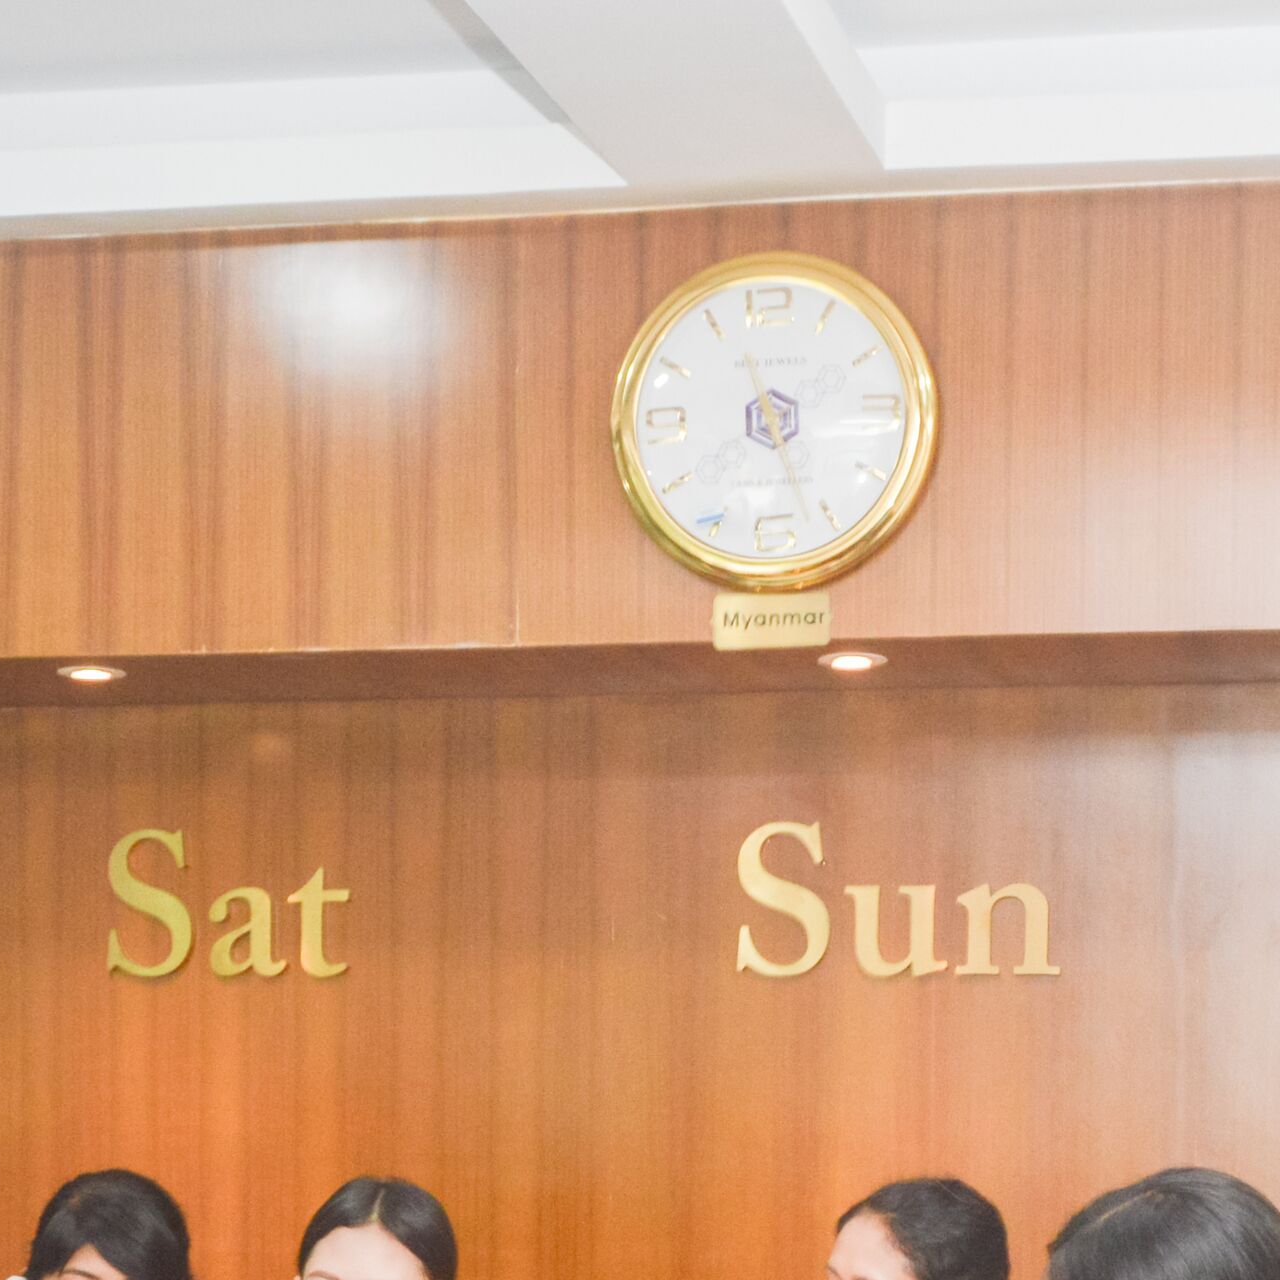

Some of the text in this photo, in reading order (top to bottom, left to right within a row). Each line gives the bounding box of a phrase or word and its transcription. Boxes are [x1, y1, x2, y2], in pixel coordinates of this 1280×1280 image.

[745, 287, 796, 328] 12
[645, 406, 687, 445] 9
[862, 393, 900, 433] 3
[754, 512, 797, 552] 6
[723, 611, 825, 630] Myanmar
[107, 827, 351, 978] Sat
[735, 820, 1062, 978] Sun
